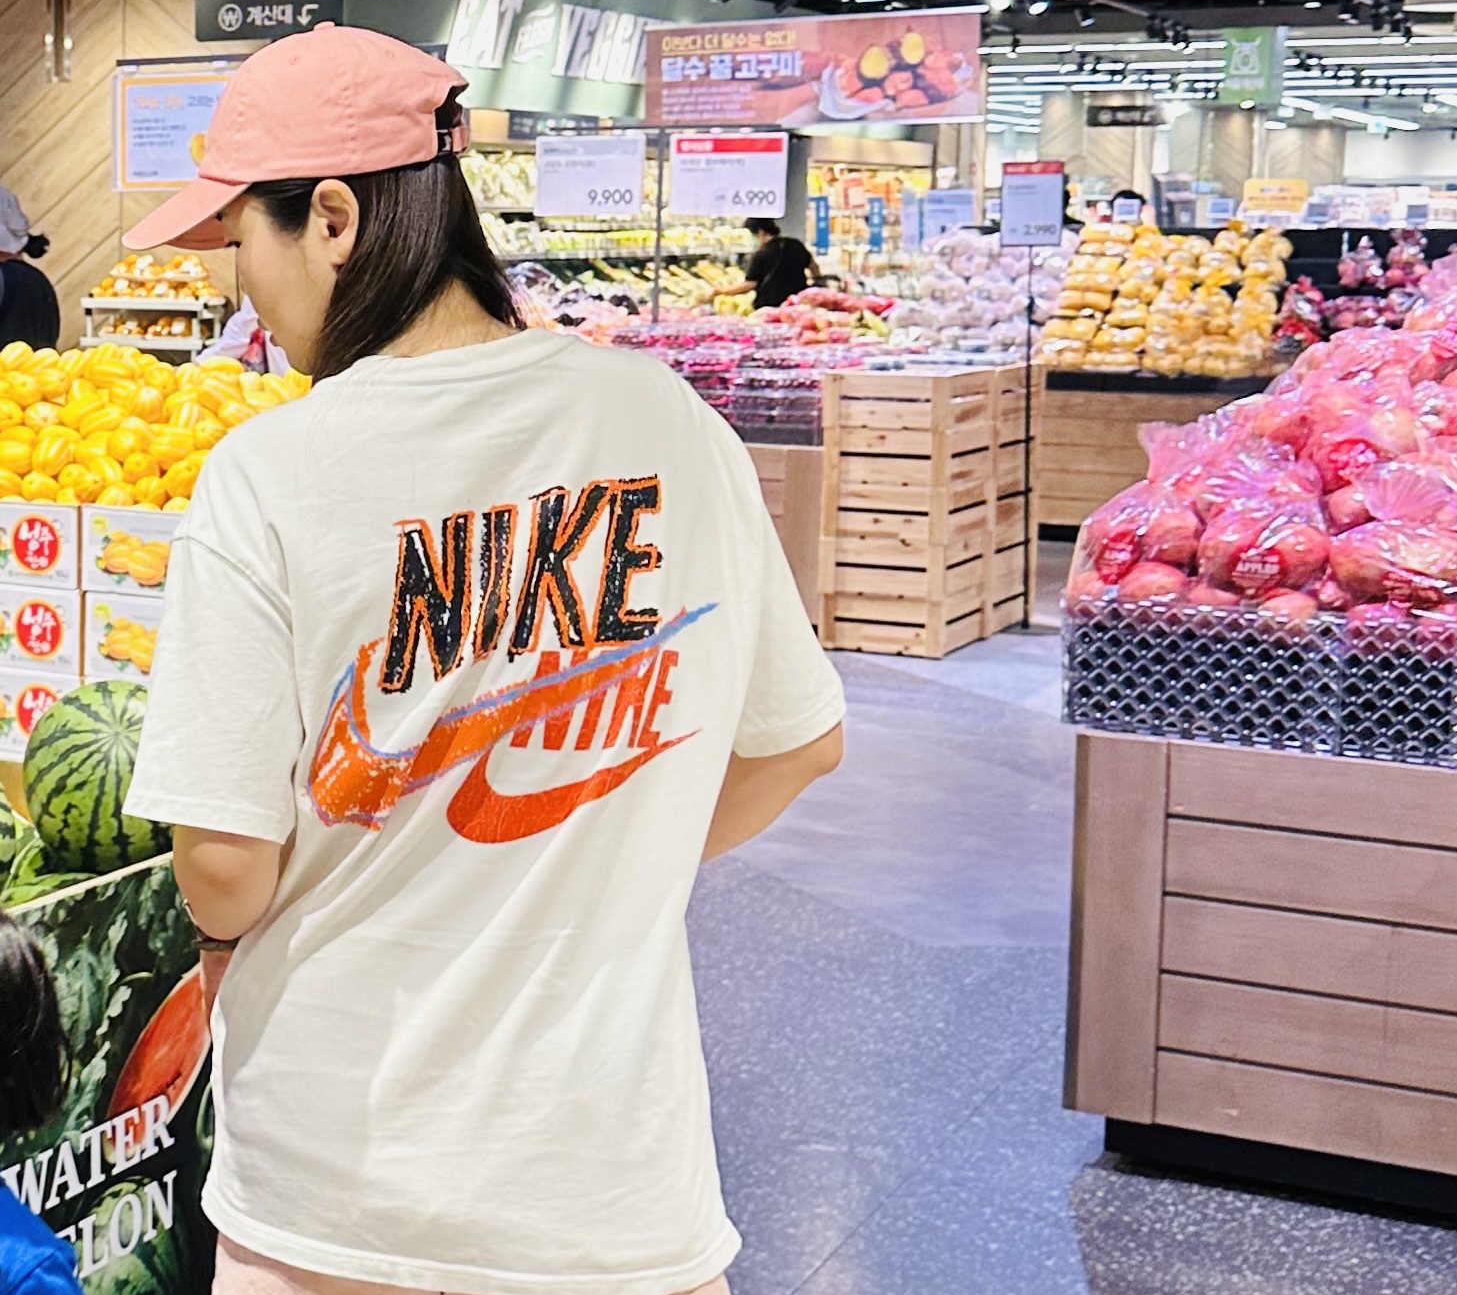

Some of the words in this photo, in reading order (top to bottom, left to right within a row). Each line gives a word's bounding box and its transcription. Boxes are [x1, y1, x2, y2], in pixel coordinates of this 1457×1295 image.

[246, 3, 294, 27] 계산대
[587, 188, 634, 207] 9,900
[731, 189, 777, 207] 6,990
[378, 473, 662, 694] NIKE
[0, 1094, 176, 1216] WATER
[54, 1169, 178, 1280] LON
